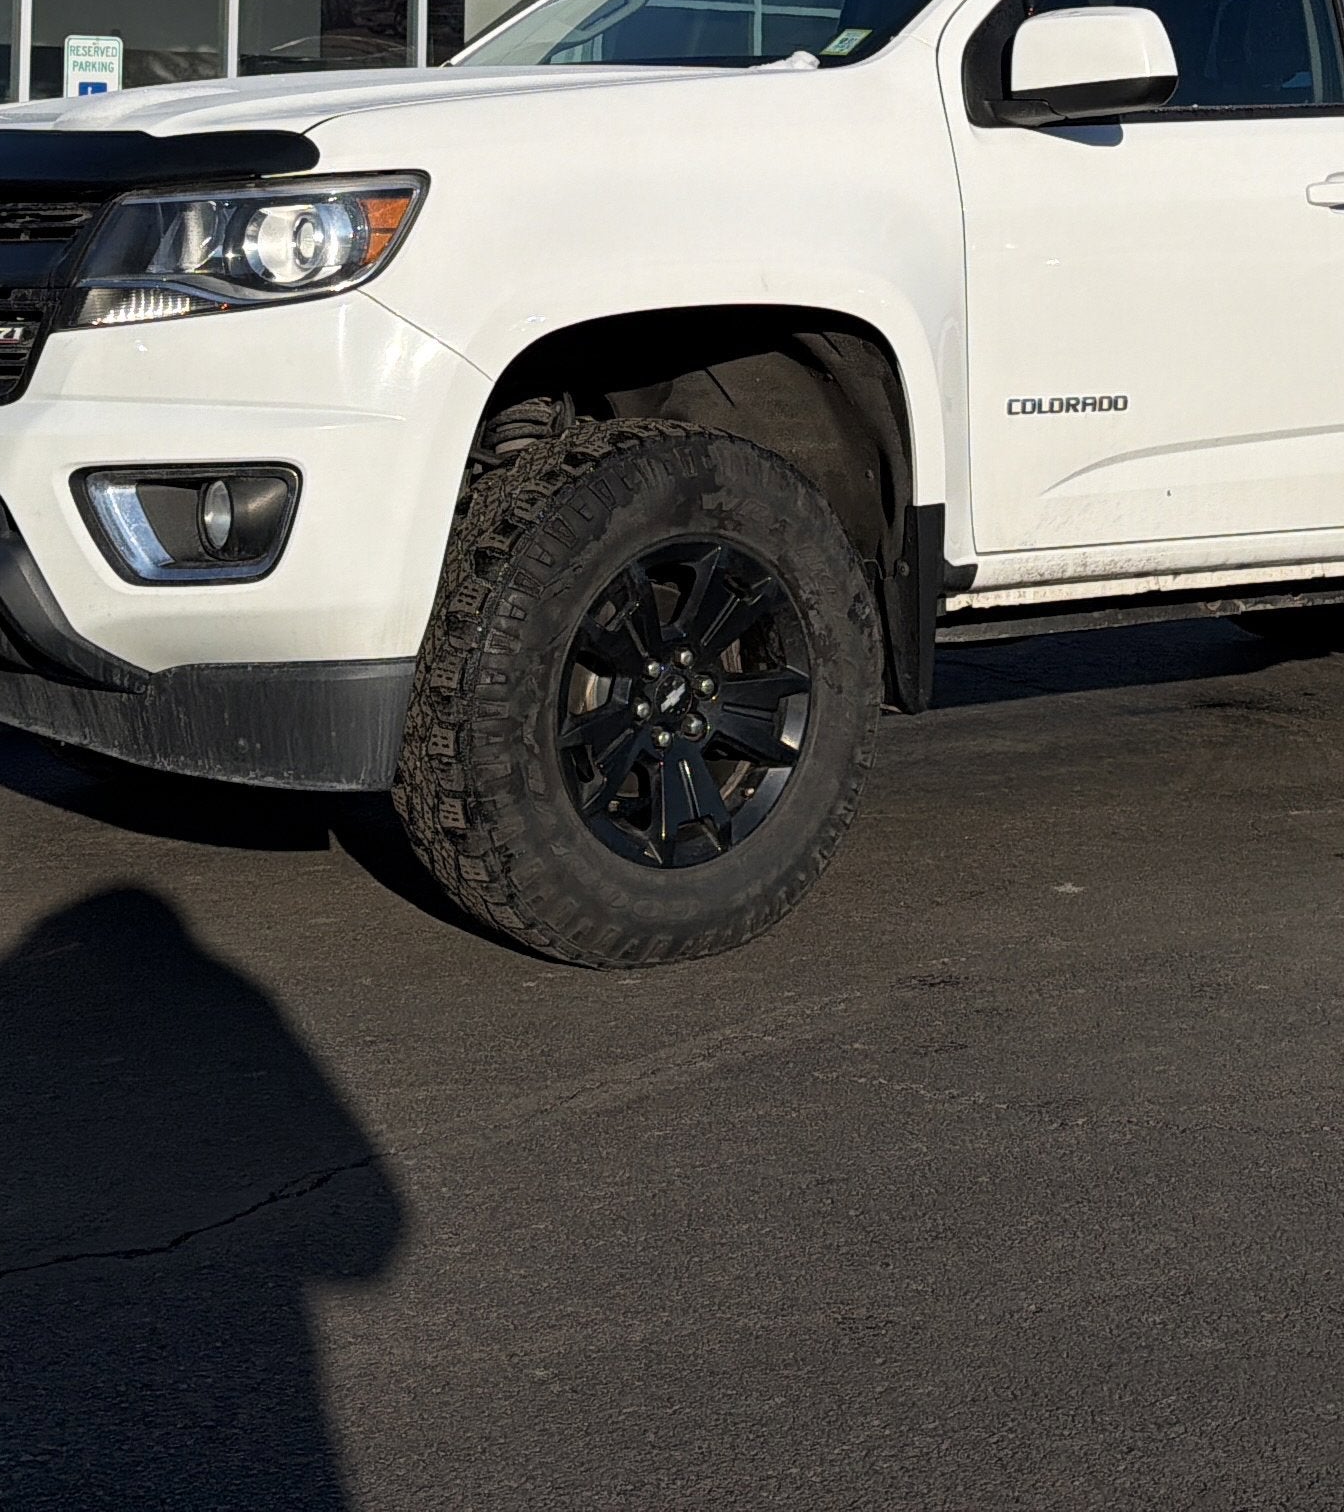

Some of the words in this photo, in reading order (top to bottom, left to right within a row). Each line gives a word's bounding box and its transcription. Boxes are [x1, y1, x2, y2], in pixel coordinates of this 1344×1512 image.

[69, 44, 118, 58] RESERVED
[72, 60, 115, 74] PARKING
[1006, 394, 1129, 416] COLORADO
